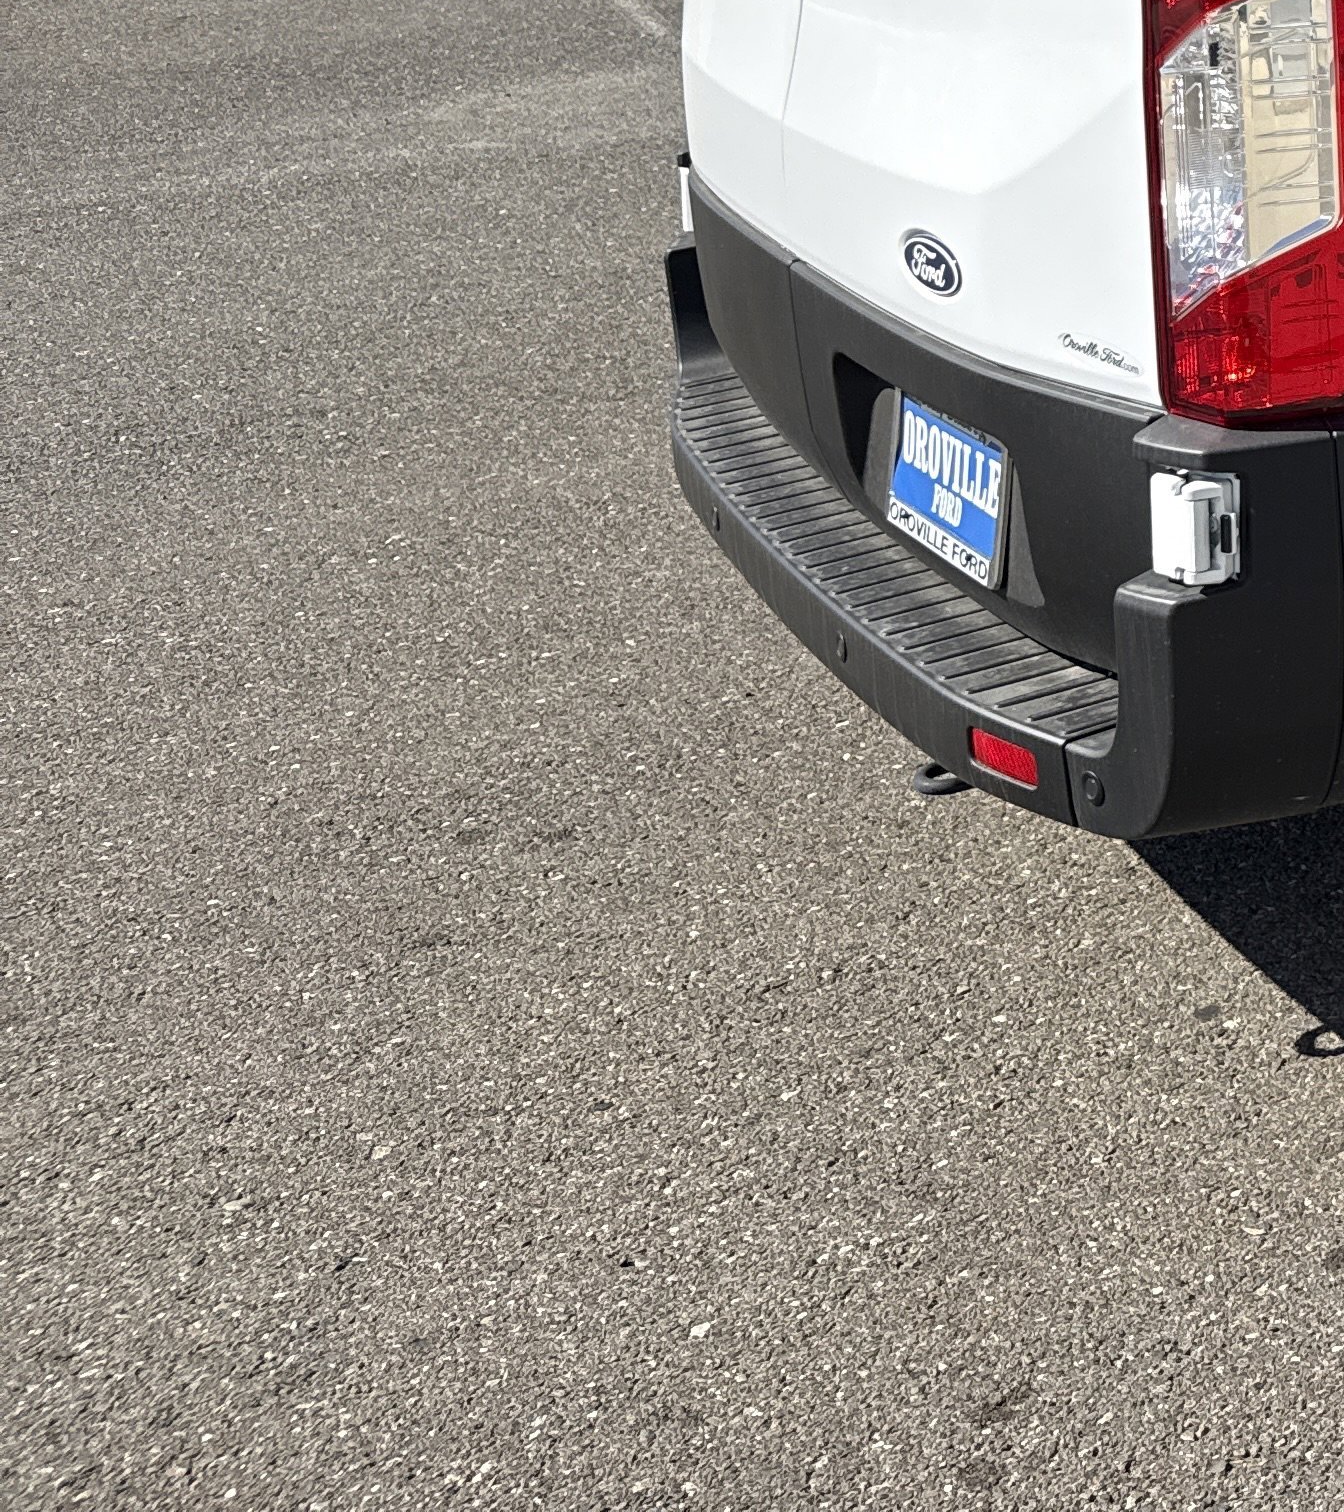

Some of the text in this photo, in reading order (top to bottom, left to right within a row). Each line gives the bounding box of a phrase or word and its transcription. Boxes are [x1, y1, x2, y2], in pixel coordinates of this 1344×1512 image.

[911, 243, 946, 288] Ford
[902, 409, 1001, 519] OROVILLE
[931, 482, 963, 528] FORD
[889, 502, 988, 580] OROVILLE FORD
